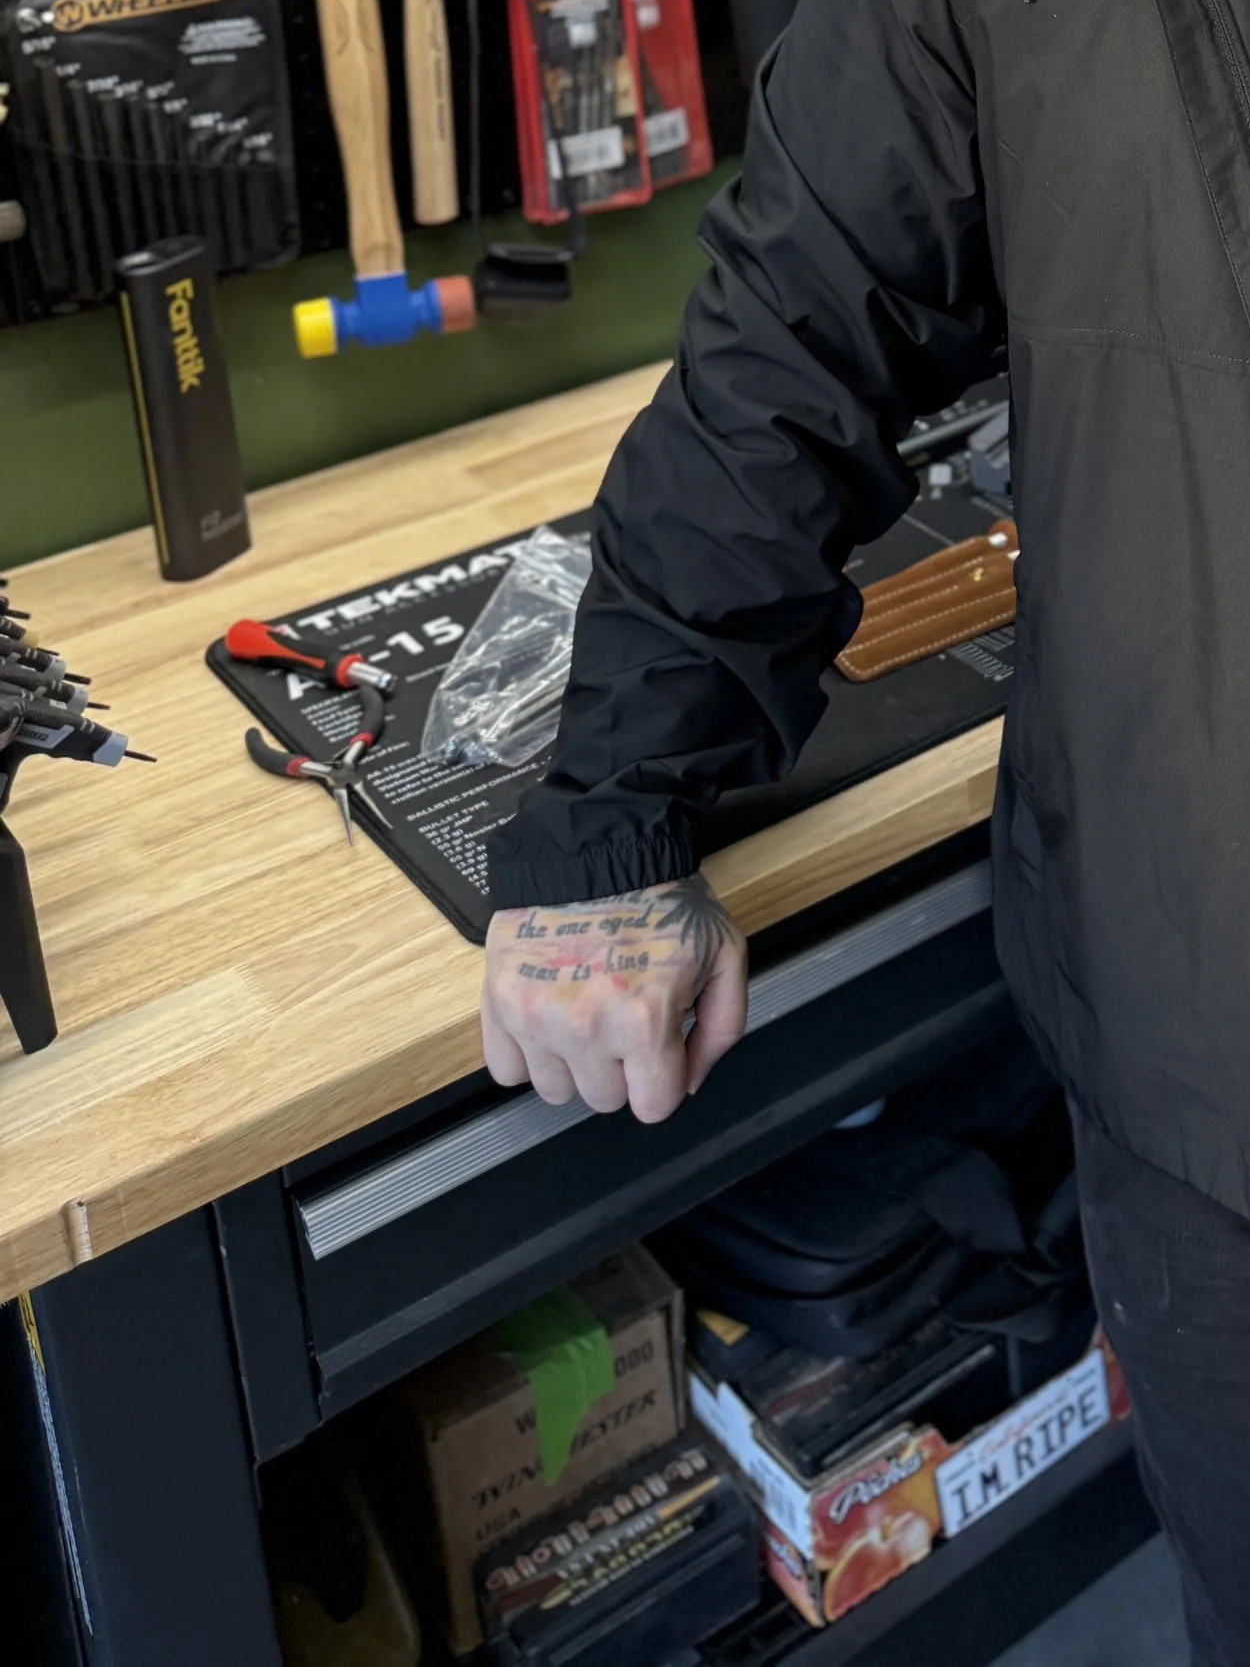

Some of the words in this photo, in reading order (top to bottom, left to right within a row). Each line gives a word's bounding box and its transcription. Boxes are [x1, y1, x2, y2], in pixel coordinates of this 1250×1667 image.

[164, 277, 205, 395] Fanttik
[296, 539, 529, 631] TEKMAT
[366, 764, 397, 780] AR-15
[373, 760, 427, 786] designated
[406, 794, 462, 823] BALLISTIC
[461, 762, 540, 799] PERFORMANCE
[418, 811, 460, 834] BULLET
[460, 799, 490, 815] TYPE
[515, 912, 547, 940] the
[555, 919, 591, 937] one
[598, 905, 652, 935] eyed
[517, 960, 560, 982] man
[571, 960, 591, 982] is
[602, 942, 651, 975] king
[471, 1389, 657, 1510] WINESTER
[1012, 1385, 1103, 1479] RIPE
